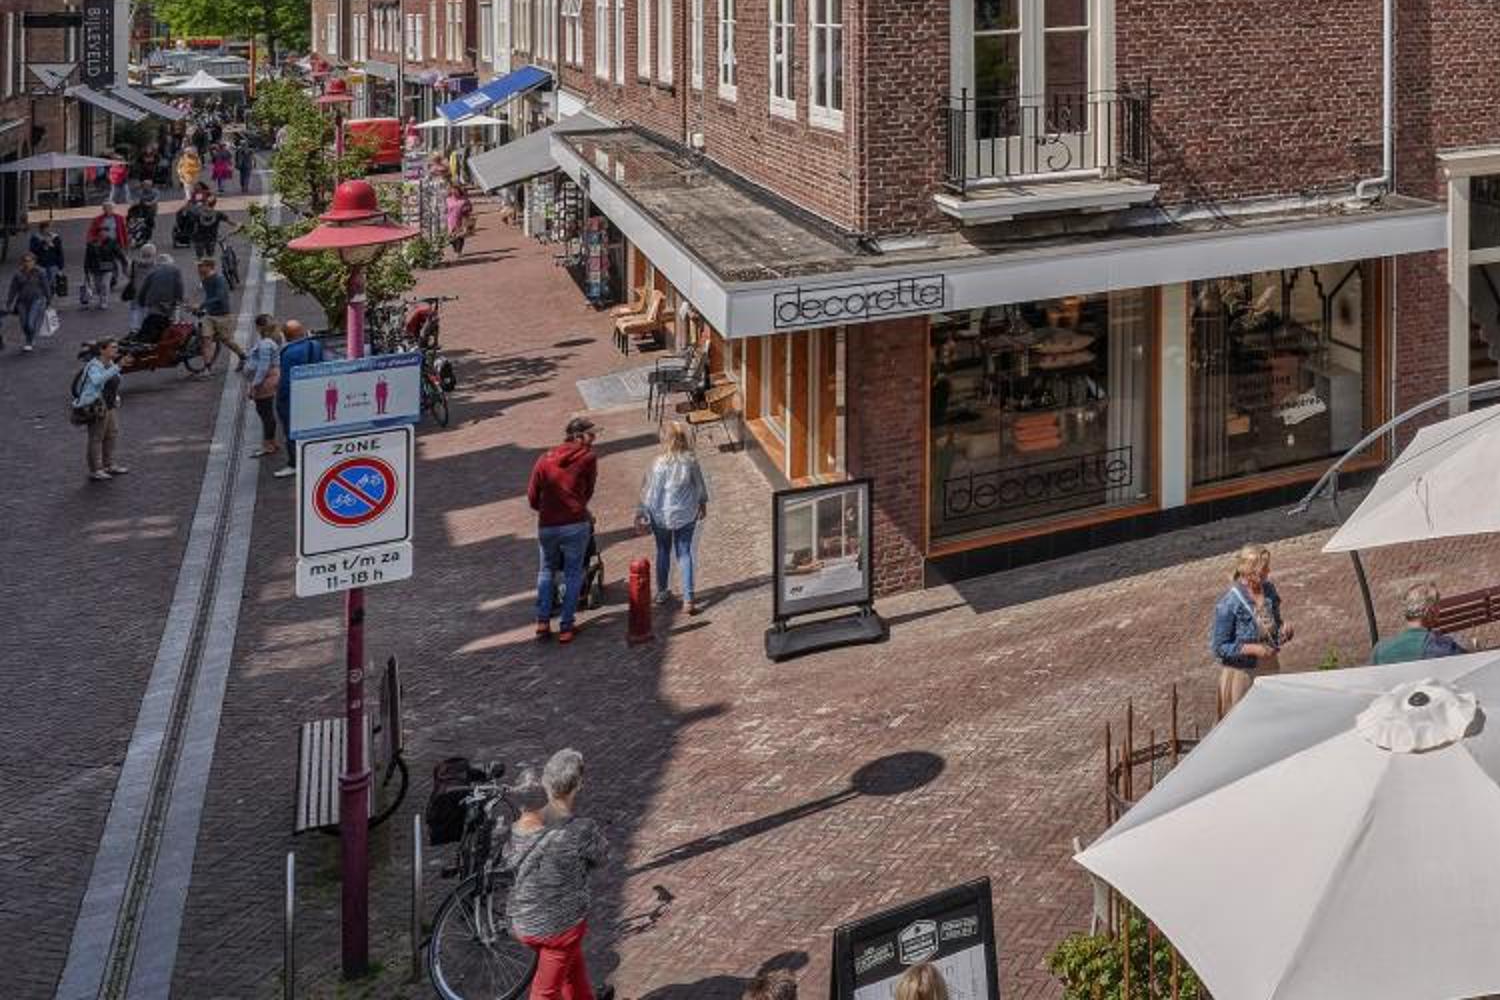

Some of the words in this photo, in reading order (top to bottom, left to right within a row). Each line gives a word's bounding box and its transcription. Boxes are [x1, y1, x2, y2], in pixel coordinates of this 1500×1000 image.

[777, 277, 940, 323] decorette
[333, 439, 380, 454] ZONE
[949, 455, 1127, 513] decorette
[310, 562, 337, 576] ma
[343, 555, 375, 570] t/m
[382, 552, 399, 563] za
[327, 571, 368, 589] 11-18
[373, 568, 383, 580] h
